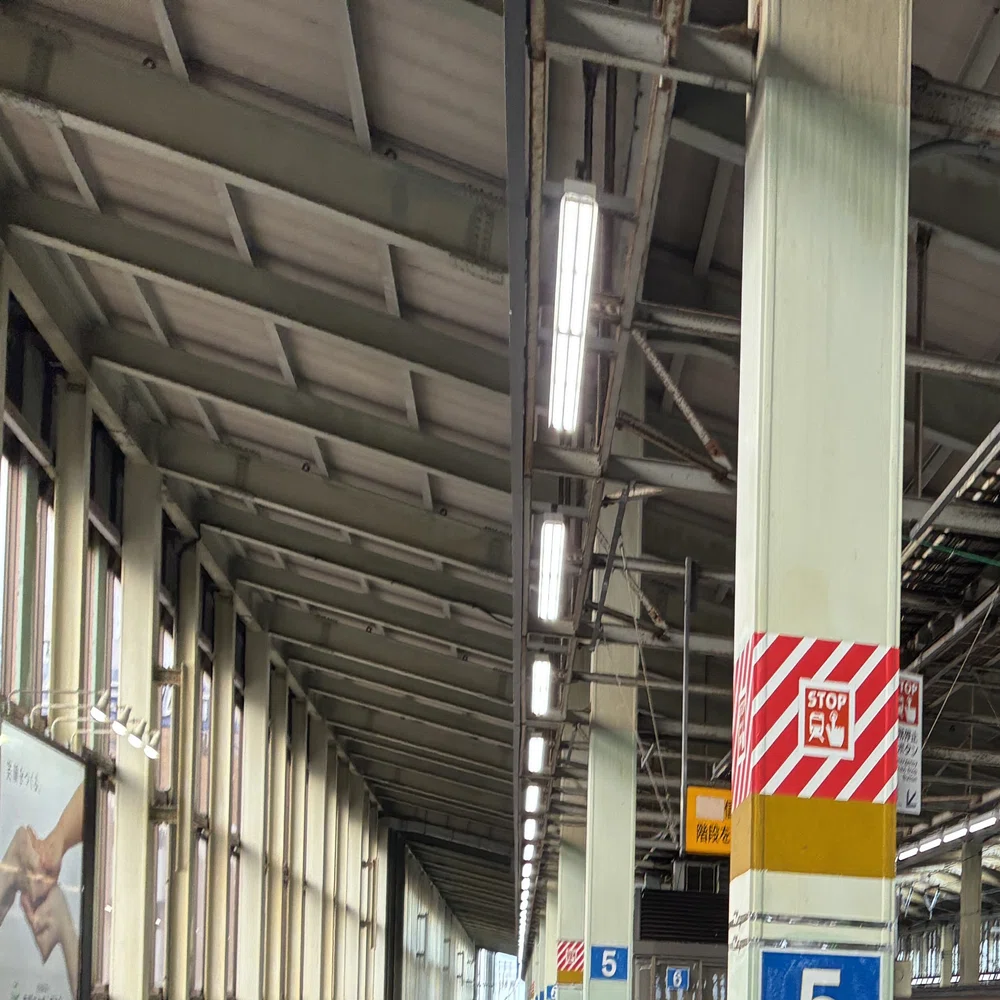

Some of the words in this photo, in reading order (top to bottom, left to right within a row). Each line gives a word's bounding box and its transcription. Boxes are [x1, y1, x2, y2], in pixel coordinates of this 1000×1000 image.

[899, 681, 918, 696] TOP
[807, 690, 848, 711] STOP
[601, 949, 617, 978] 5
